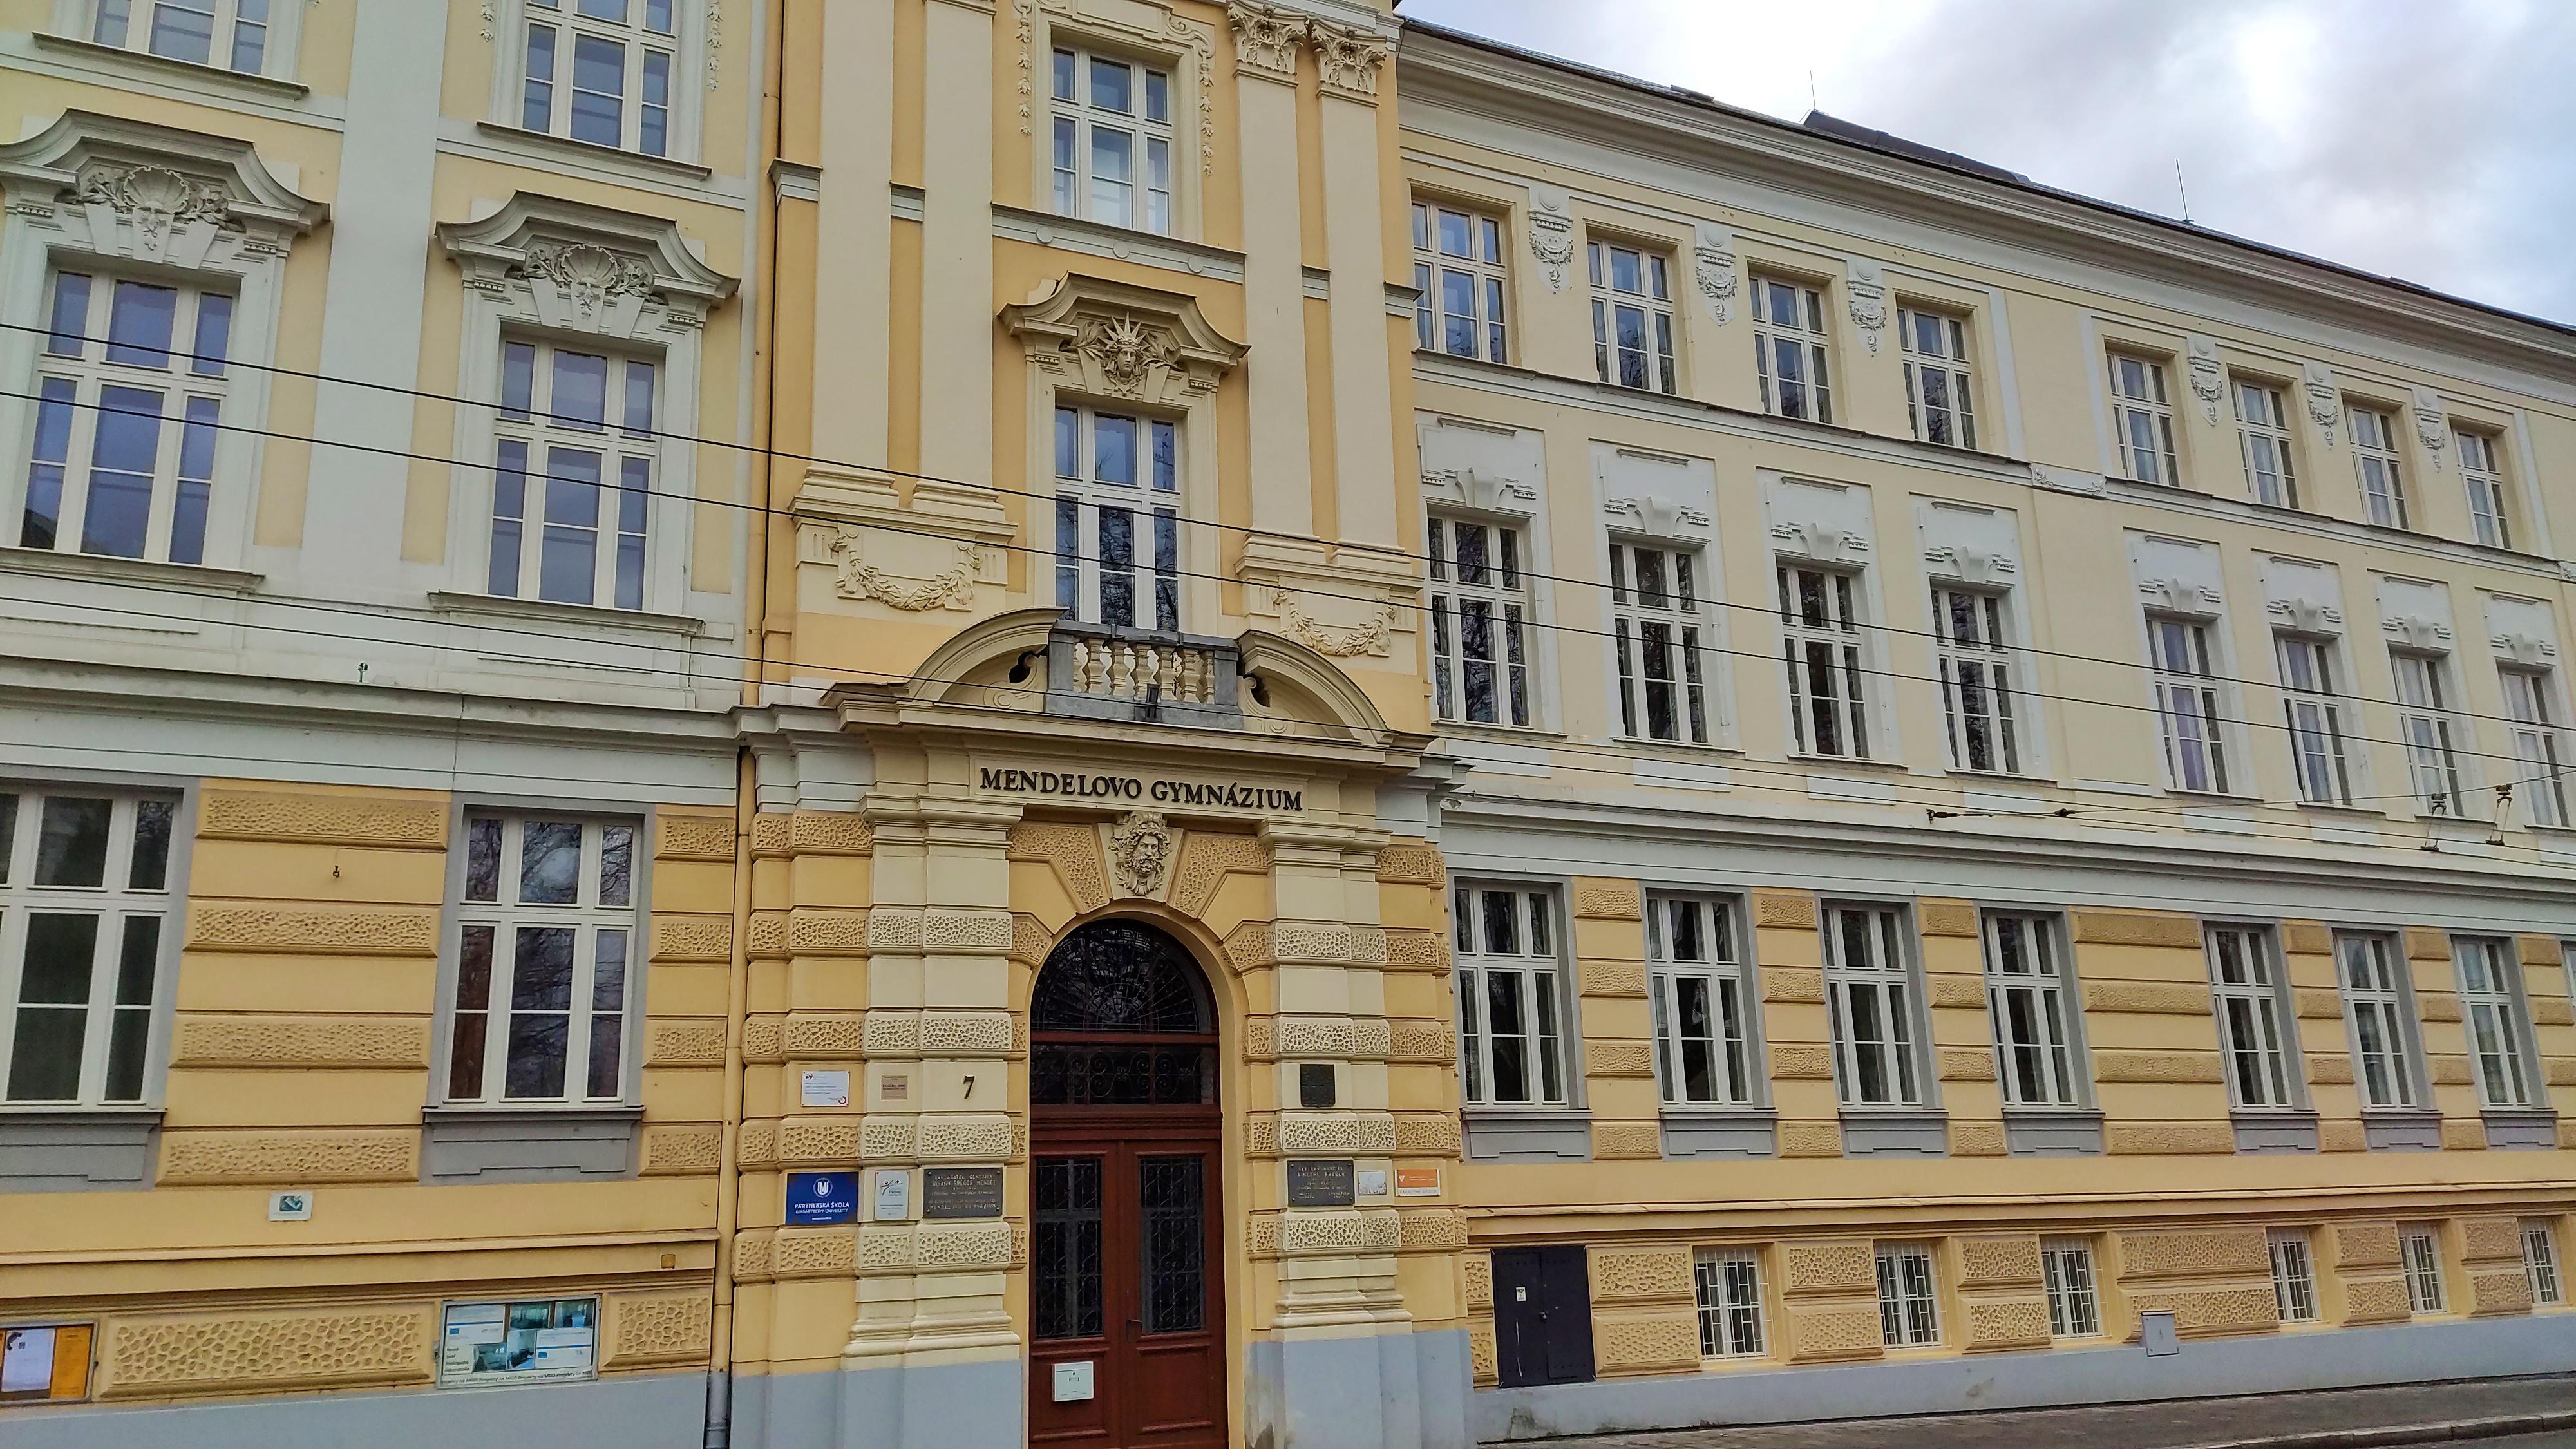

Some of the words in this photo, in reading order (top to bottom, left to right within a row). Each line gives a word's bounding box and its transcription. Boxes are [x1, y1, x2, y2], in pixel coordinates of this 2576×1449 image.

[980, 767, 1142, 799] MENDELOVO
[1150, 781, 1303, 811] GYMNÁZIUM
[963, 1075, 975, 1099] 7
